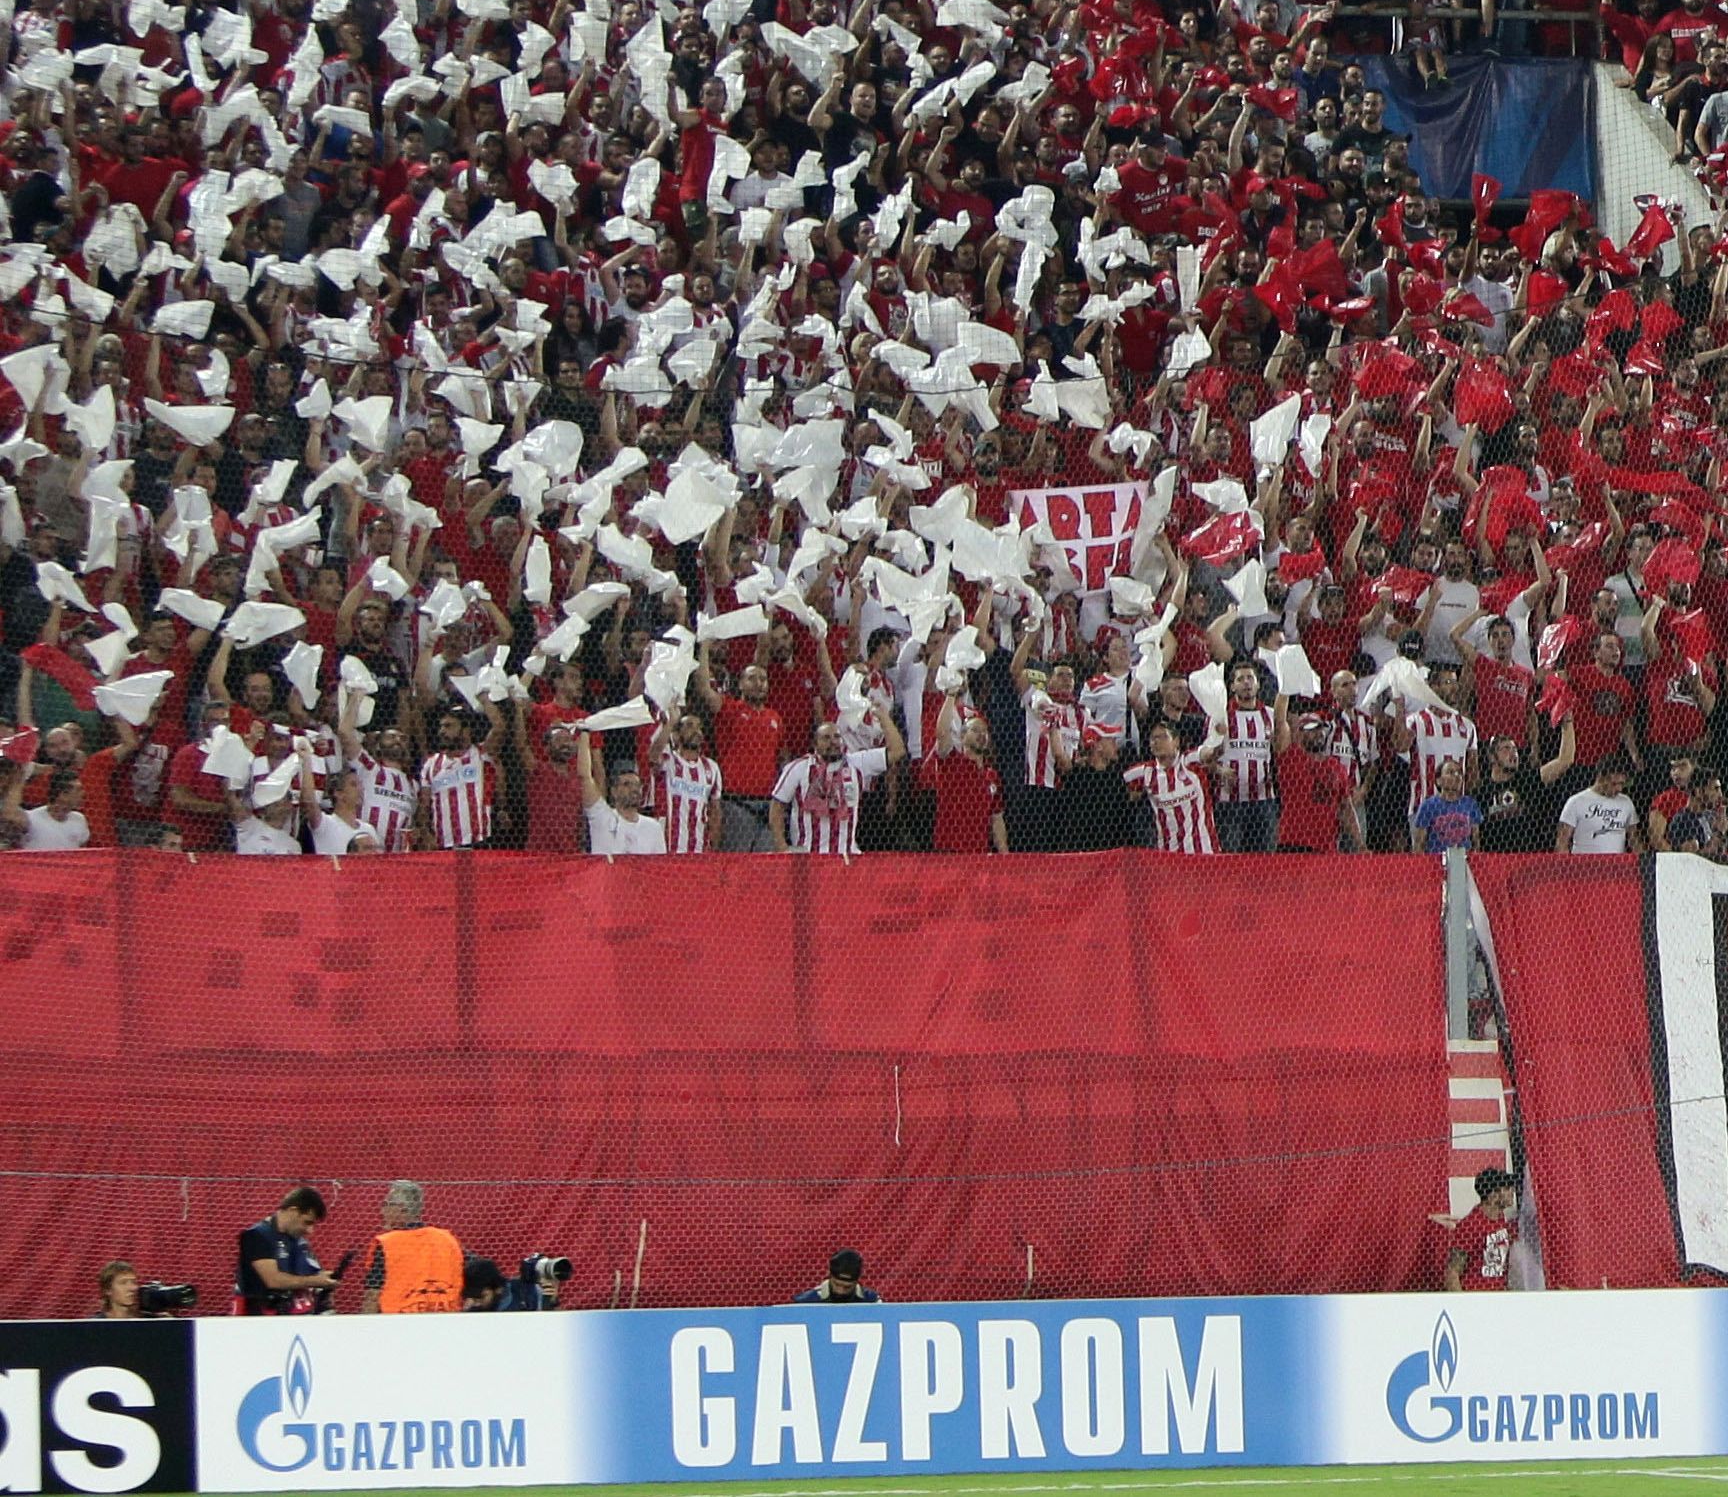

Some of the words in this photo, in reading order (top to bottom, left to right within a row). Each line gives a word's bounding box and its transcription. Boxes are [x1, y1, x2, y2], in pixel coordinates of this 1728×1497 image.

[671, 1314, 1245, 1468] GAZPROM
[1467, 1391, 1660, 1443] GAZPROM
[324, 1418, 527, 1471] GAZPROM
